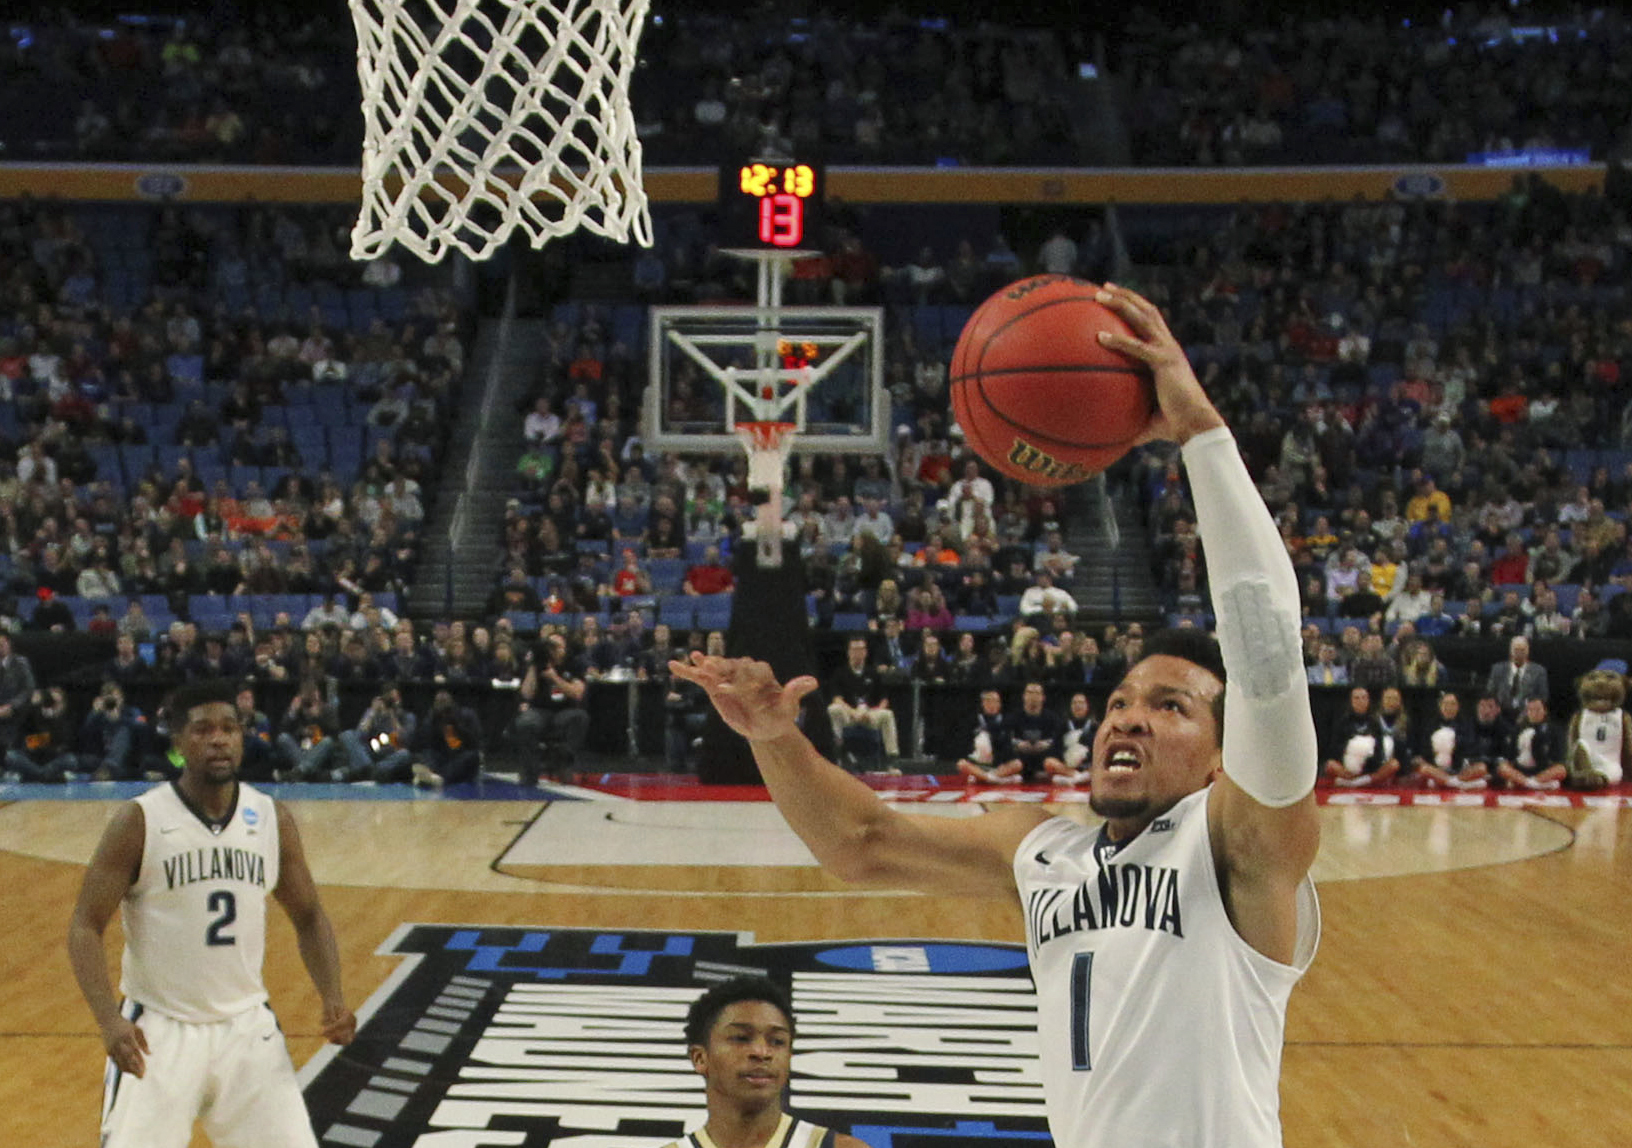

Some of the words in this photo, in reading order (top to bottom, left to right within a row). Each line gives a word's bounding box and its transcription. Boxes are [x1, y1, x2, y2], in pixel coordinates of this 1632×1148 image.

[740, 164, 815, 197] 12:13
[759, 194, 804, 247] 13
[163, 846, 266, 889] VILLANOVA
[206, 889, 237, 946] 2
[1070, 951, 1095, 1071] 1
